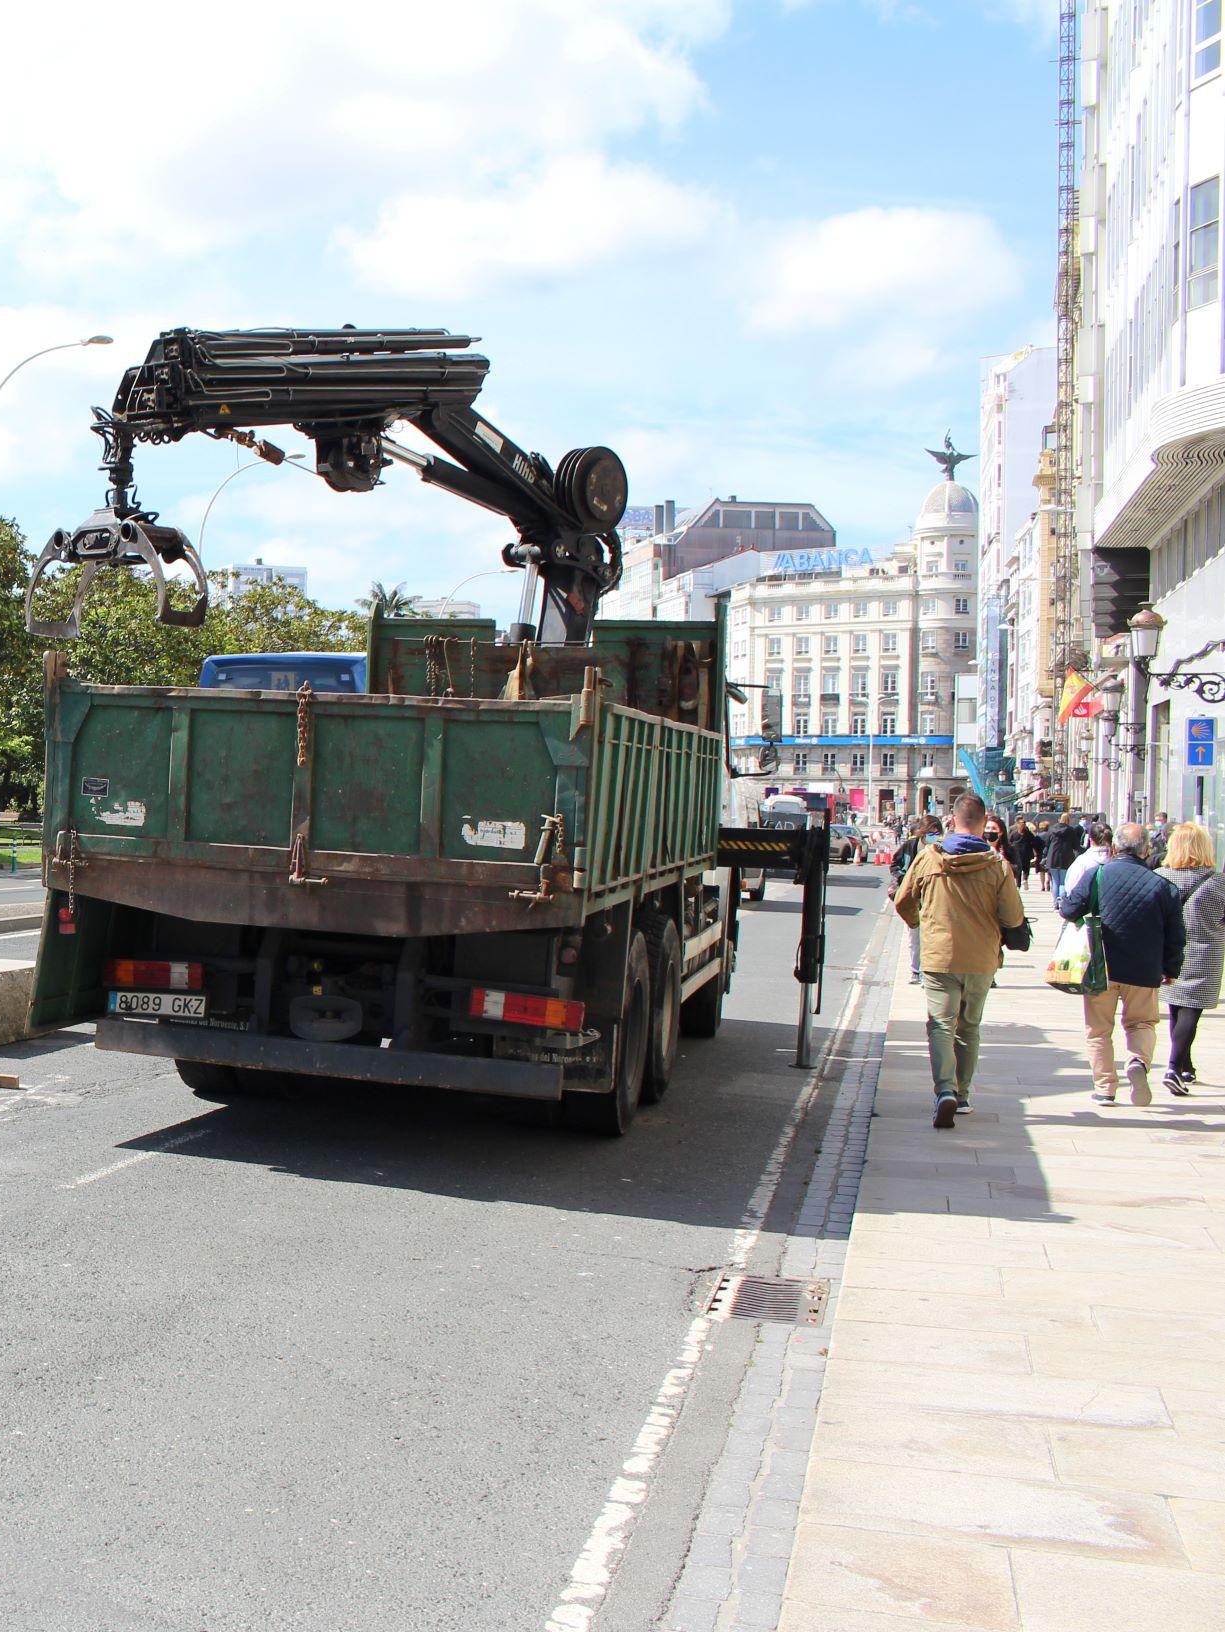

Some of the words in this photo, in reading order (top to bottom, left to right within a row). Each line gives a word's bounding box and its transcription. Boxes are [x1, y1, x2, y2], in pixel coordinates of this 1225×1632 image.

[773, 547, 874, 572] ABANCA
[118, 994, 162, 1012] 8089
[171, 997, 204, 1015] GKZ
